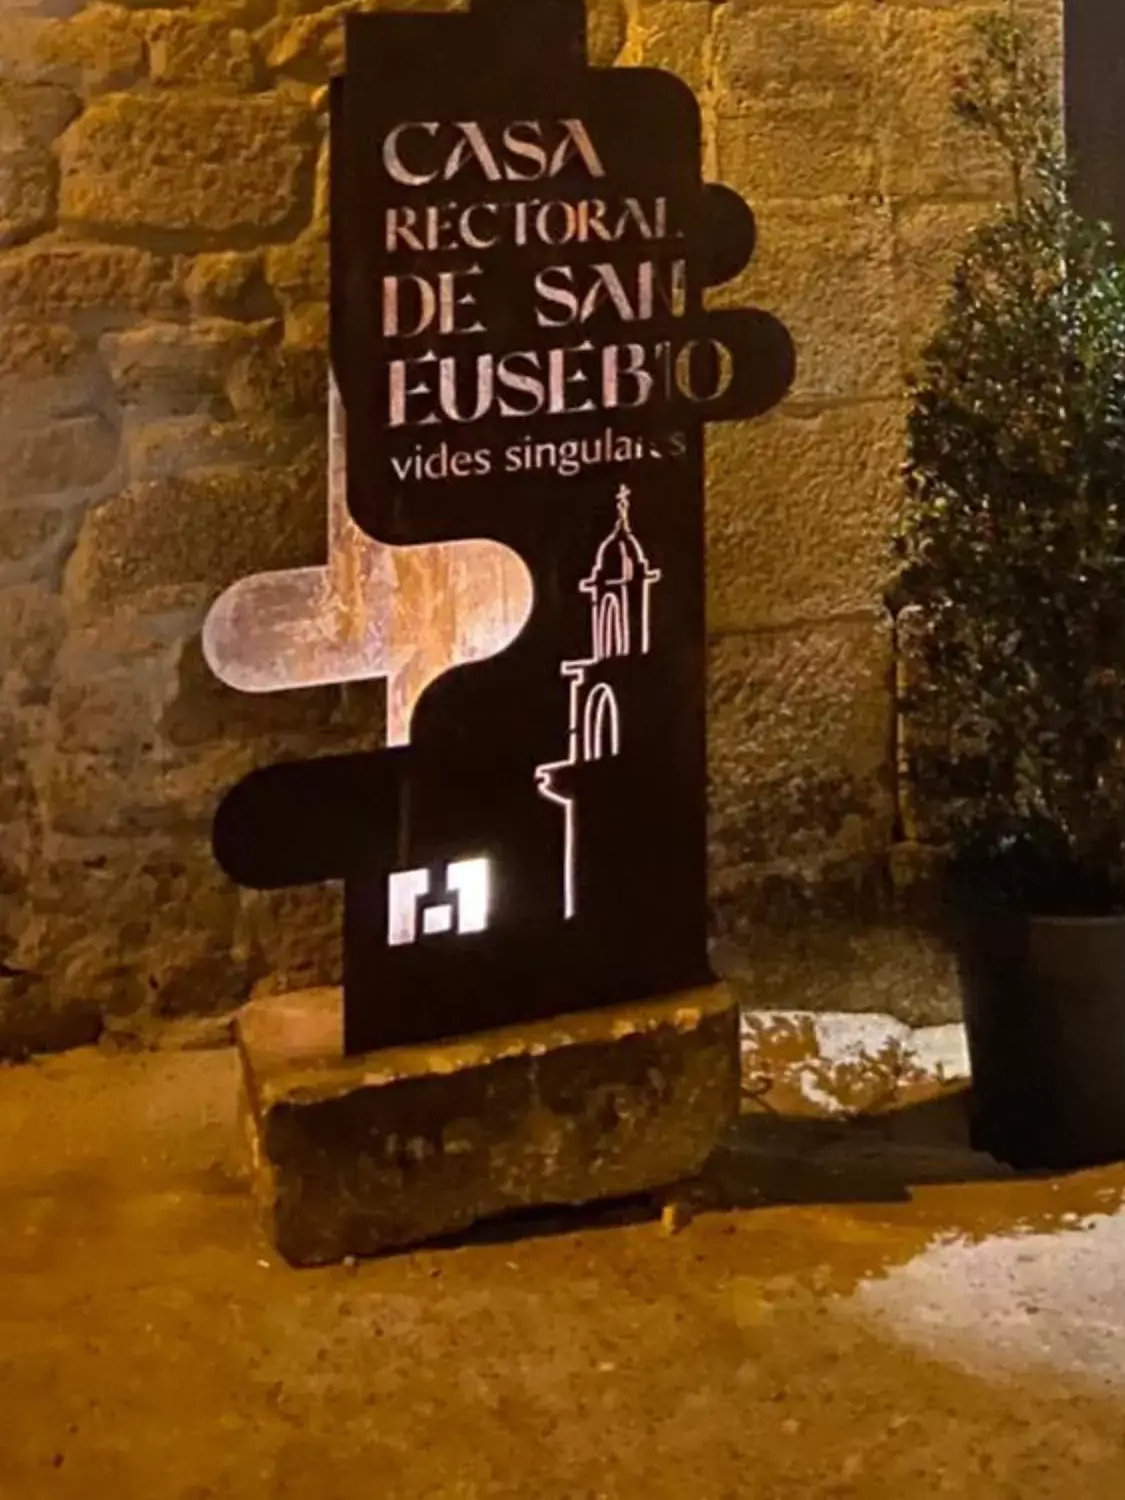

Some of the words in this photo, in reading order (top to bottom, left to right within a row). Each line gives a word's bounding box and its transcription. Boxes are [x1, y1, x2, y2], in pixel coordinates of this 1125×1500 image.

[382, 118, 606, 186] CASA
[386, 196, 684, 252] RECTORAL
[382, 265, 487, 337] DE
[534, 259, 686, 329] SAN
[386, 338, 734, 427] EUSEBIO
[391, 443, 493, 481] vides
